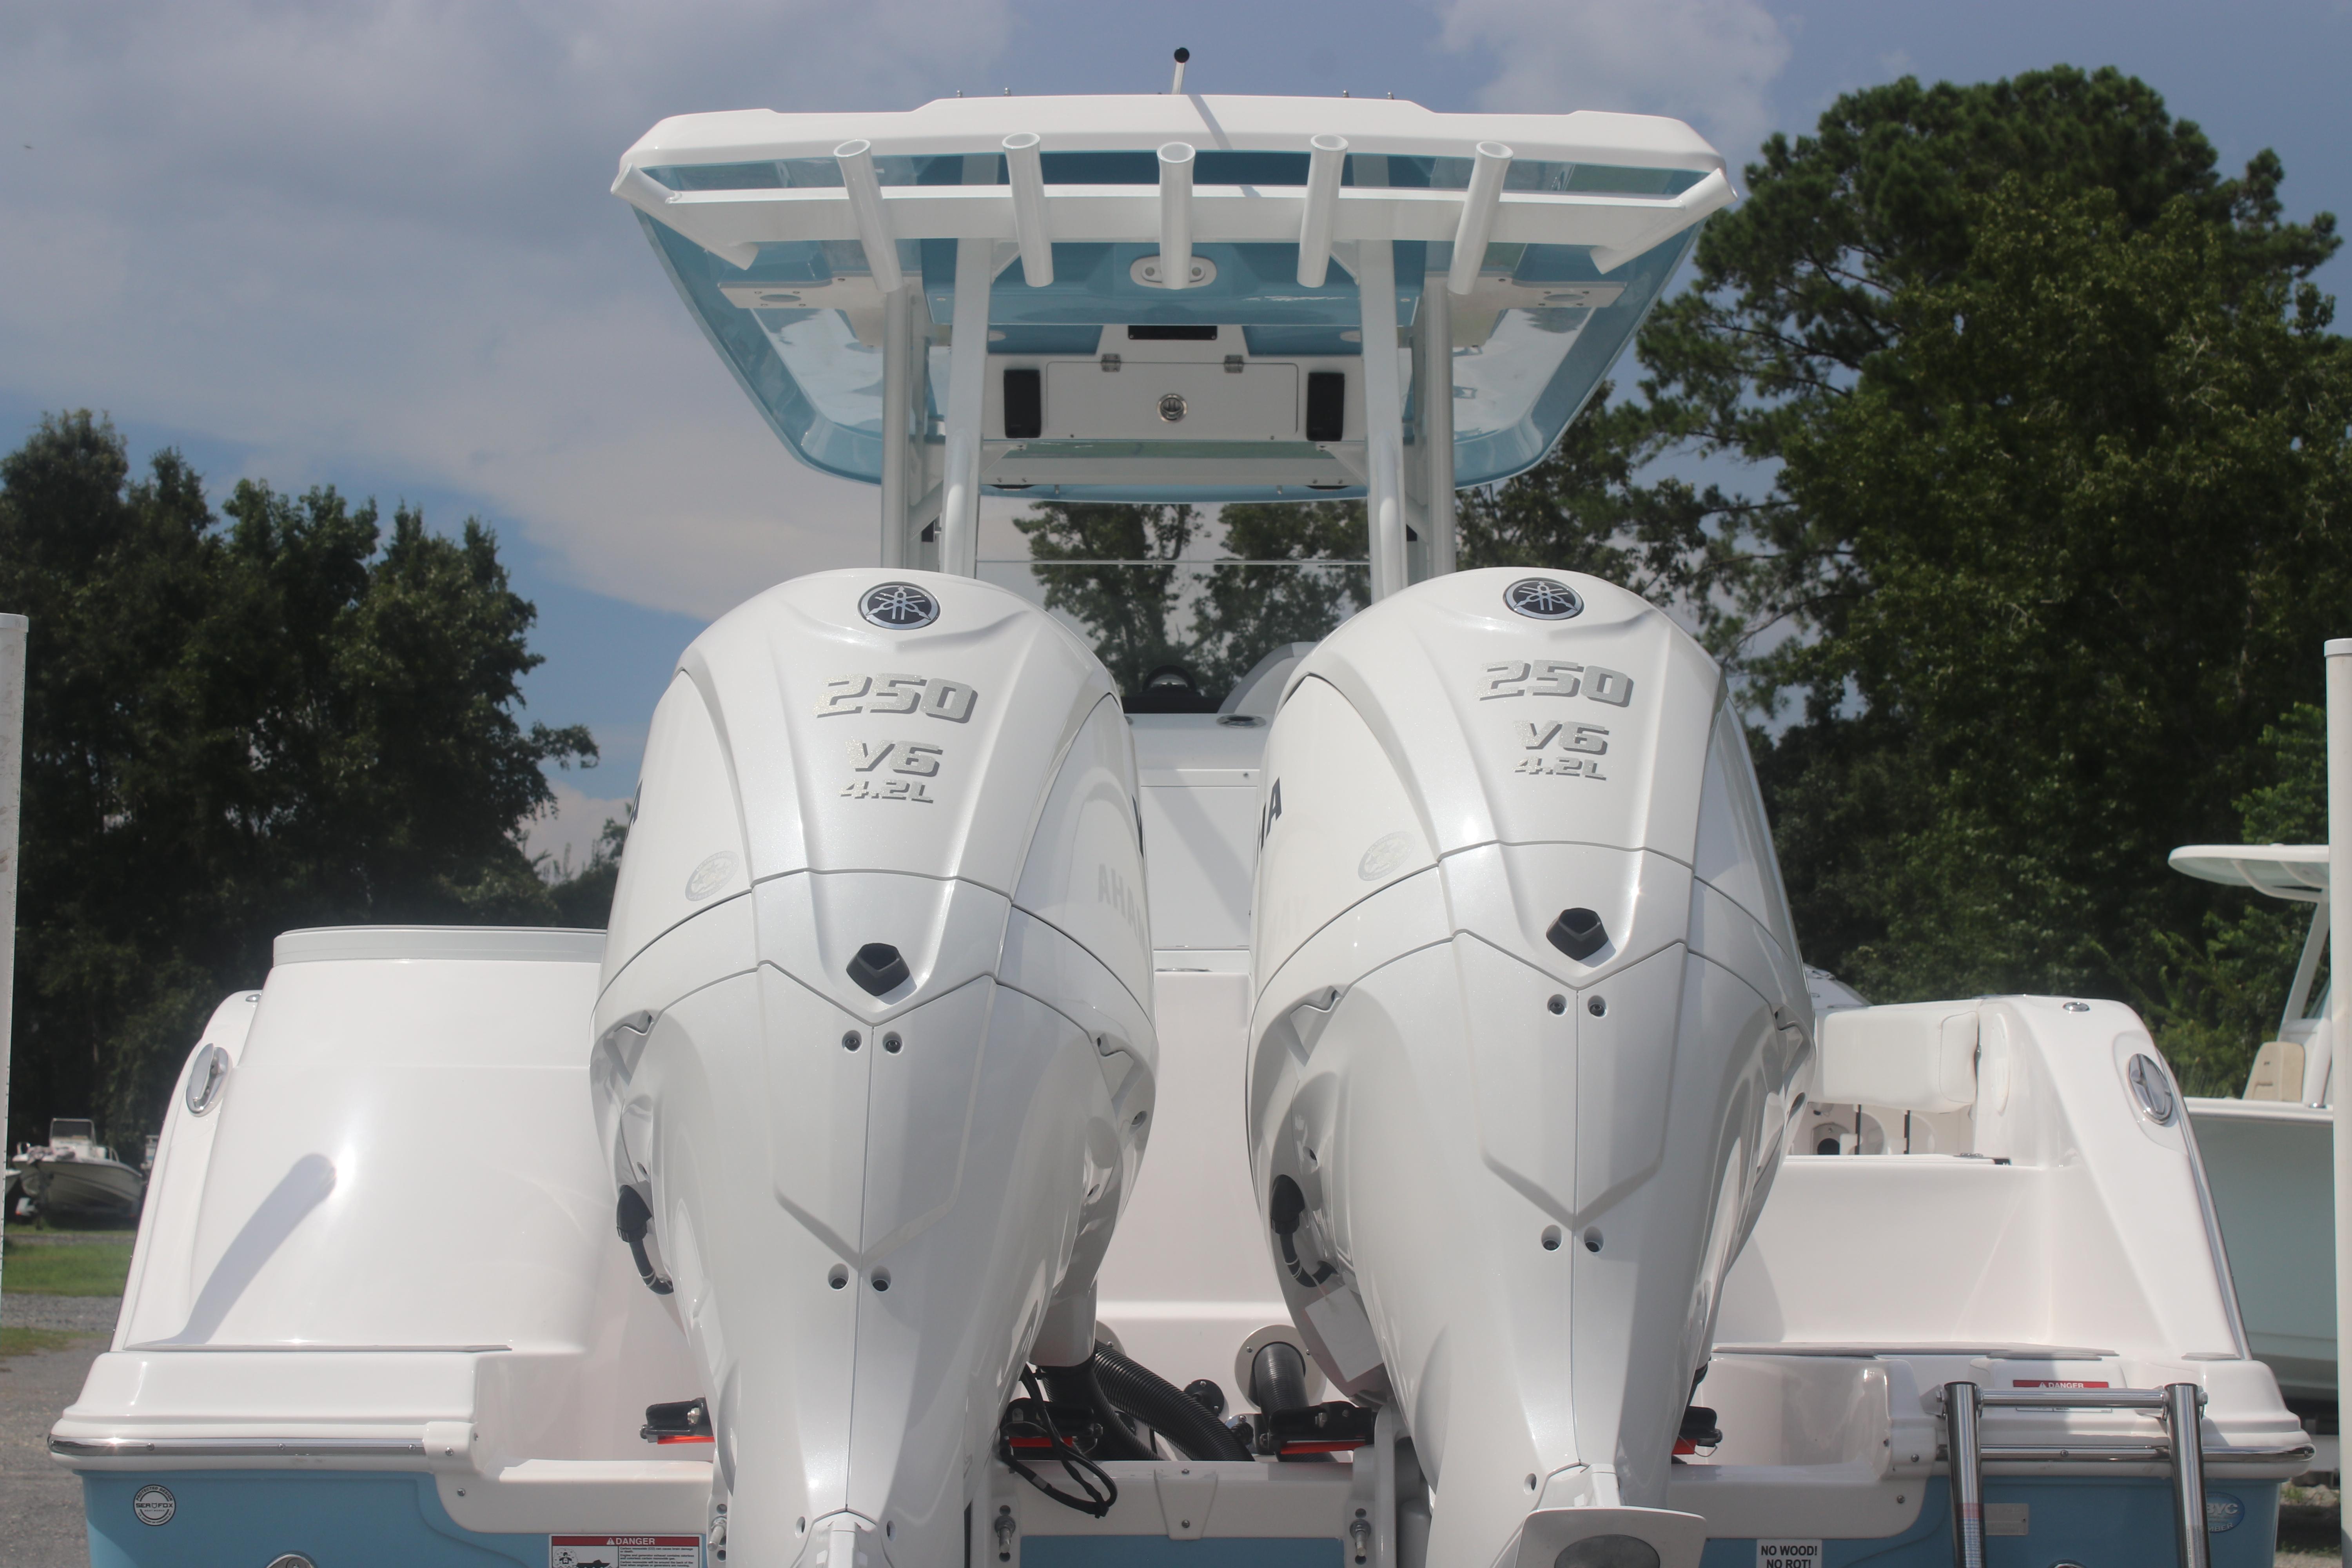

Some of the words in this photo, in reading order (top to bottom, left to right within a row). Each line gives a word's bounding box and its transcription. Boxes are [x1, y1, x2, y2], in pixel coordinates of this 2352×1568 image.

[1473, 659, 1634, 708] 250
[812, 673, 978, 724] 250
[1513, 720, 1609, 755] V6
[845, 740, 943, 777] V6
[1512, 756, 1607, 780] 4.2L
[838, 779, 934, 804] 4.2L
[136, 1486, 158, 1501] PROTECTED
[159, 1488, 173, 1501] DESIGN
[2207, 1503, 2239, 1514] BYC
[2208, 1523, 2234, 1532] MBER
[1761, 1545, 1777, 1555] NO
[1780, 1545, 1817, 1555] WOOD!
[1767, 1559, 1782, 1568] NO
[1786, 1559, 1811, 1568] ROT!
